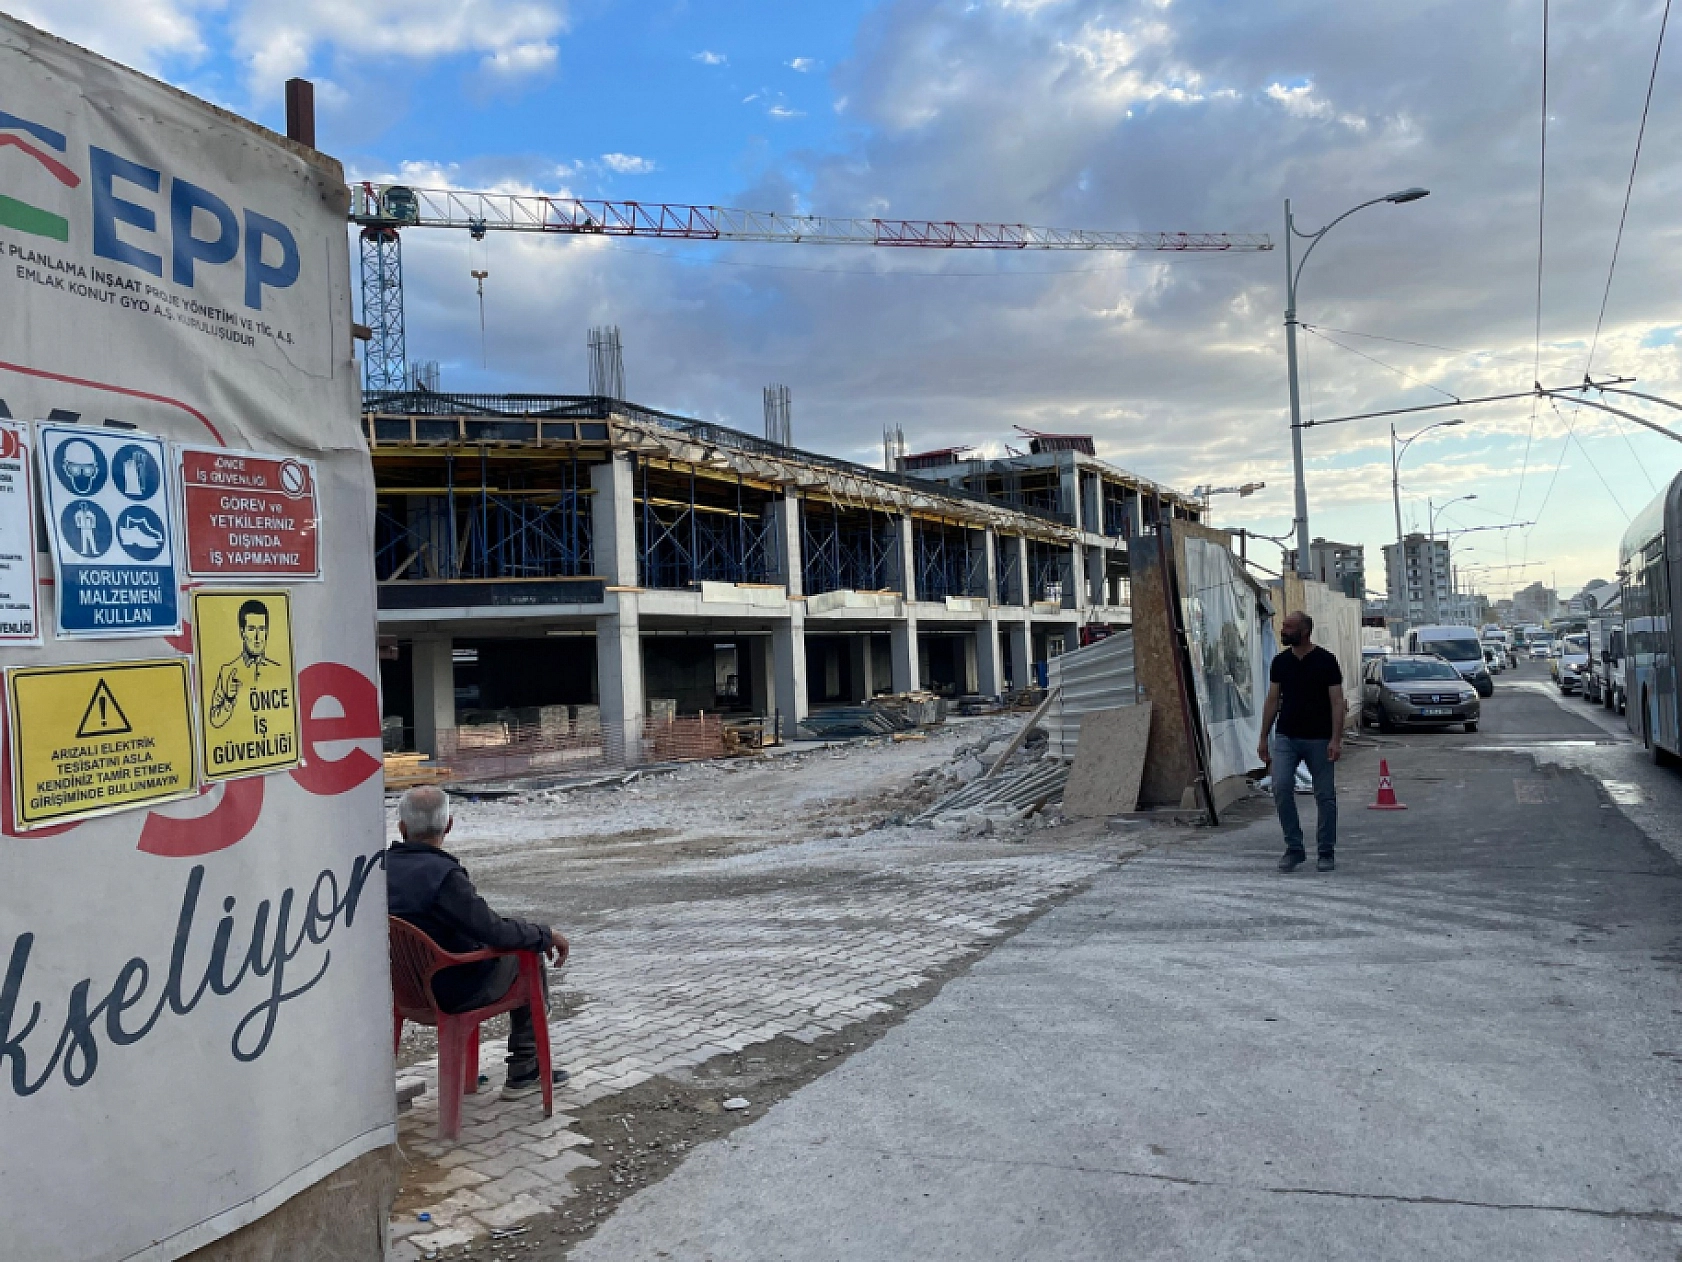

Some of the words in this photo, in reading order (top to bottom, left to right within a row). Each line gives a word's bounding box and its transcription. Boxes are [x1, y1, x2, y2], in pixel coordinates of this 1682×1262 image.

[9, 243, 87, 279] PLANLAMA
[90, 265, 142, 293] İNŞAAT
[144, 284, 180, 308] PROJE
[181, 297, 238, 327] YÖNETİMİ
[239, 317, 254, 332] VE
[16, 264, 65, 291] EMLAK
[68, 280, 117, 305] KONUT
[120, 294, 150, 313] GYO
[153, 303, 175, 321] A.Ş.
[177, 311, 255, 348] KURULUŞUDUR
[214, 456, 246, 471] ÖNCE
[220, 495, 266, 512] GÖREV
[269, 503, 282, 514] ve
[209, 513, 296, 531] YETKİLERİNİZ
[228, 532, 282, 549] DIŞINDA
[209, 548, 223, 567] İŞ
[226, 551, 300, 566] YAPMAYINIZ
[78, 569, 159, 586] KORUYUCU
[78, 586, 163, 605] MALZEMENİ
[93, 608, 152, 625] KULLAN
[250, 687, 290, 712] ÖNCE
[254, 715, 268, 738] İŞ
[51, 746, 98, 762] ARIZALI
[101, 735, 156, 754] ELEKTRİK
[213, 732, 292, 765] GÜVENLİĞİ
[56, 756, 120, 776] TESİSATINI
[123, 751, 154, 766] ASLA
[36, 773, 94, 793] KENDİNİZ
[97, 766, 131, 784] TAMİR
[133, 761, 173, 779] ETMEK
[30, 786, 104, 811] GİRİŞİMİNDE
[108, 774, 179, 797] BULUNMAYIN
